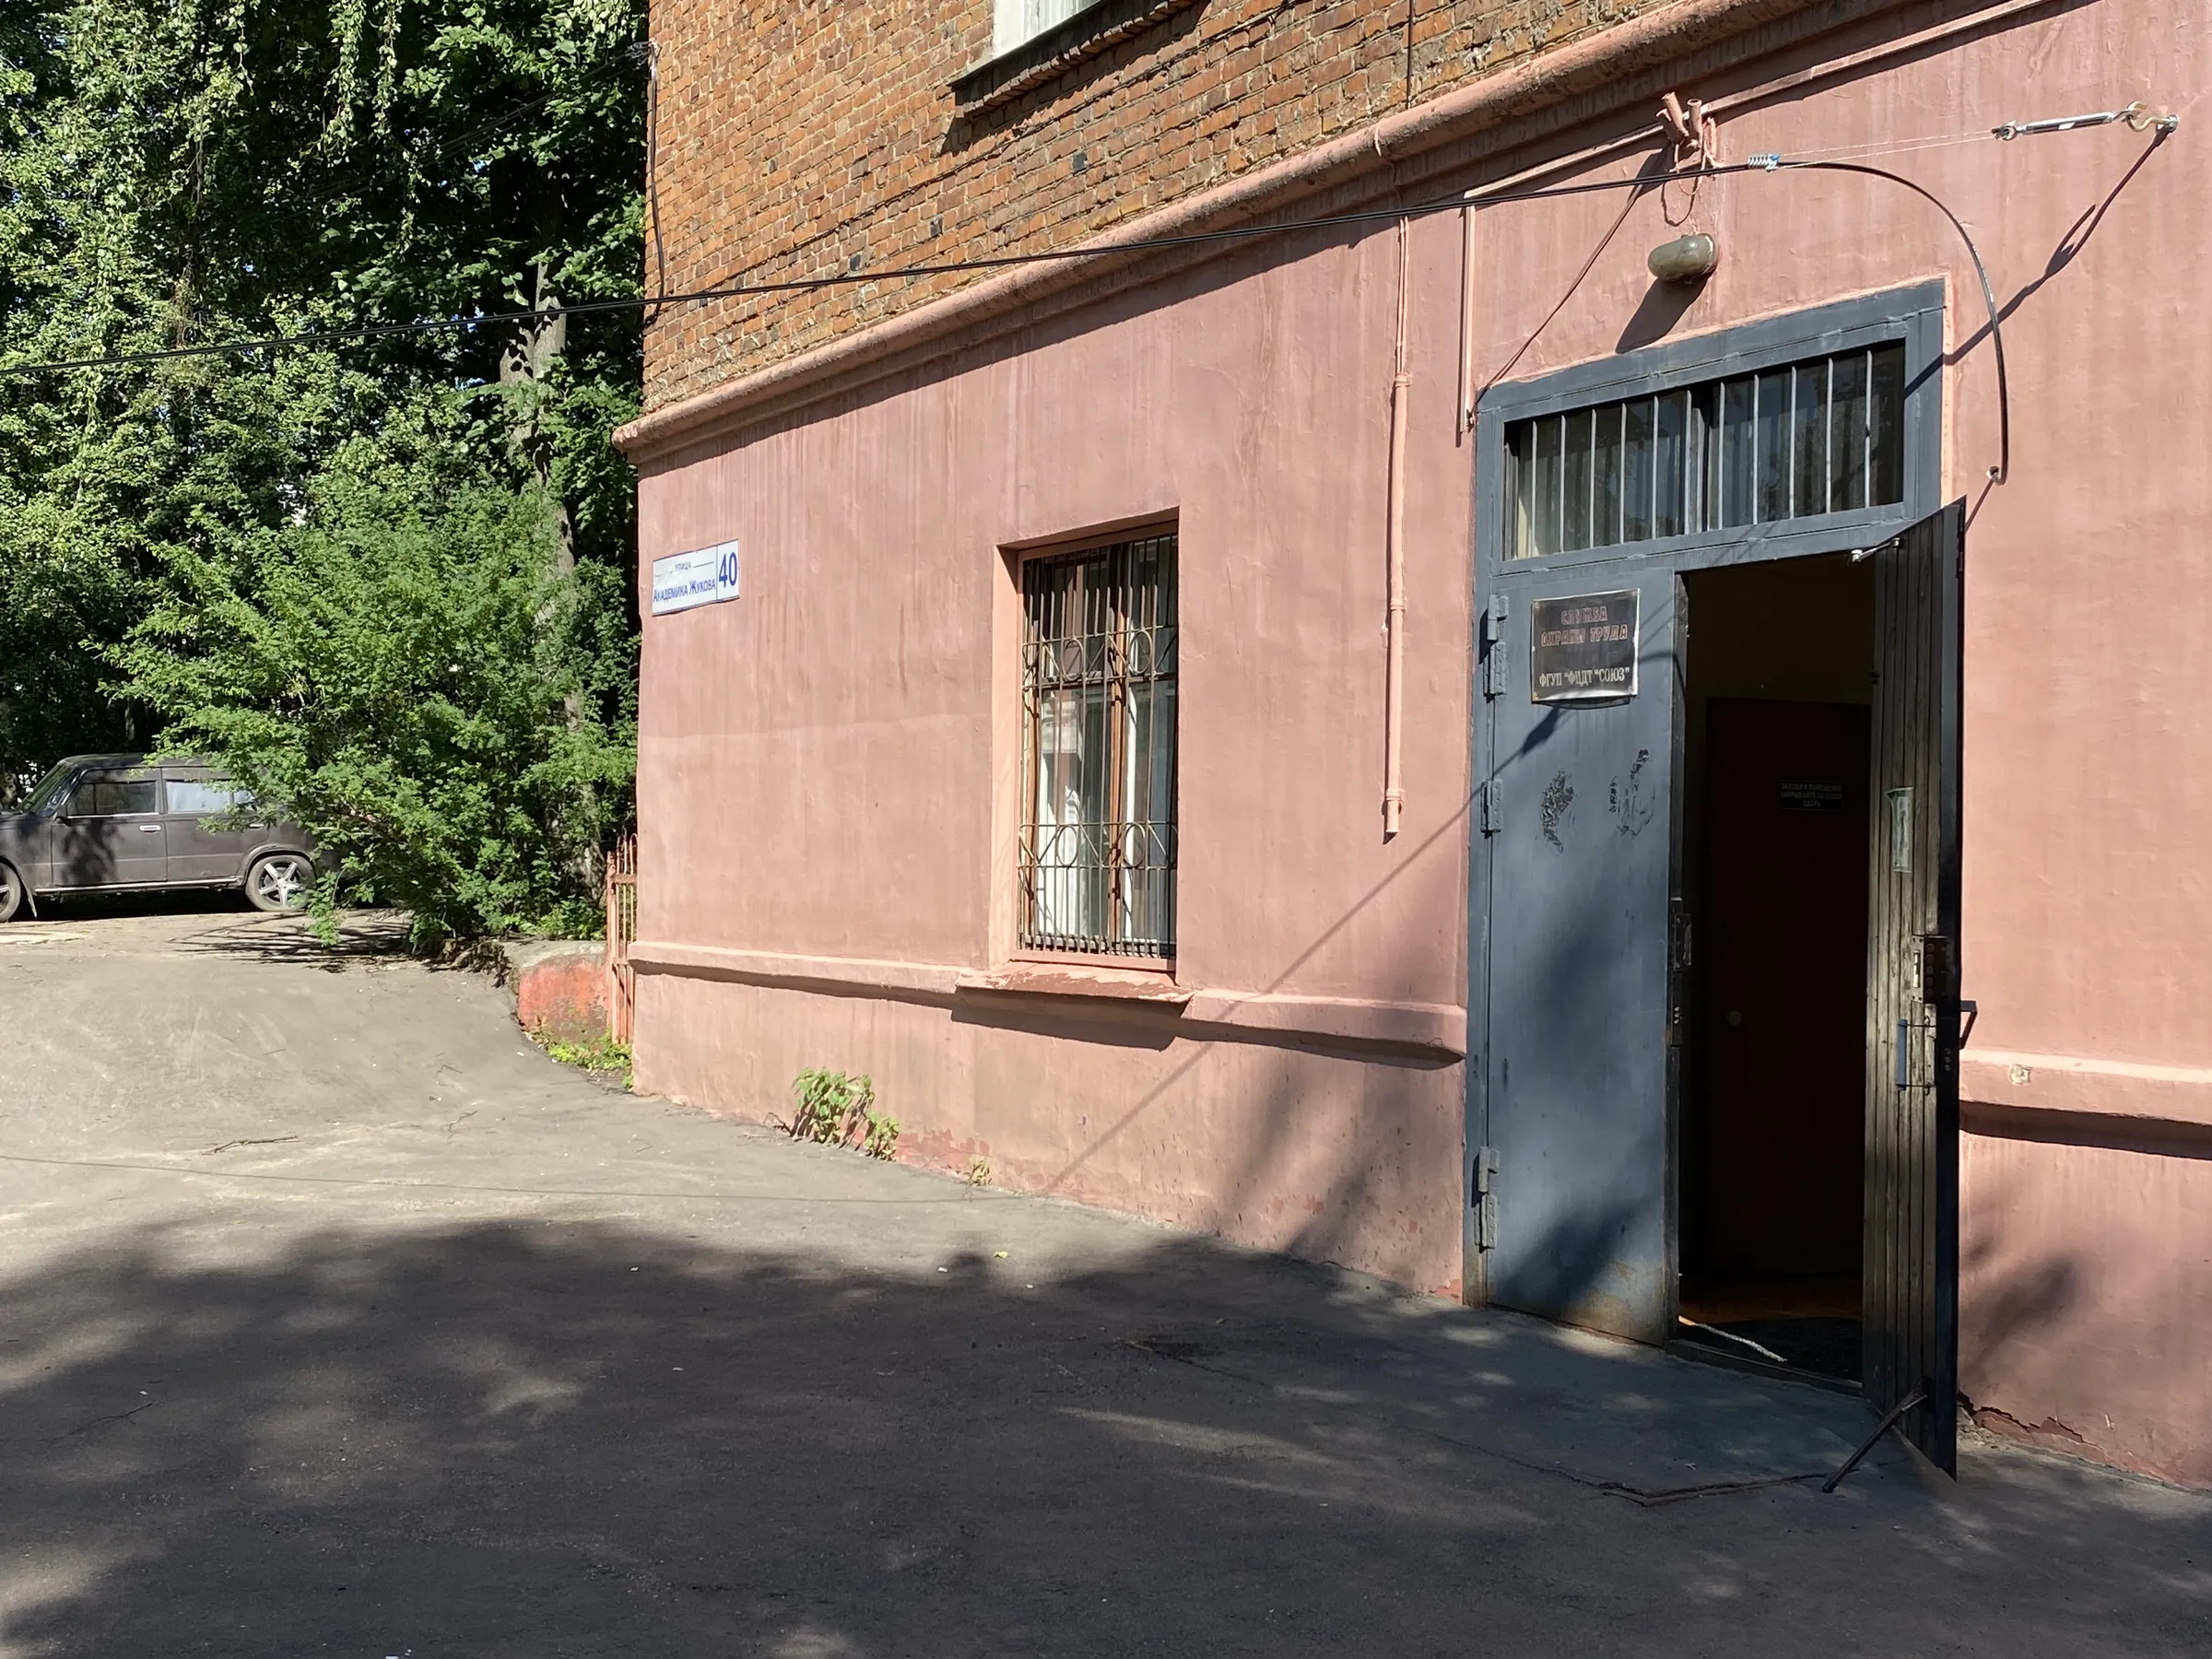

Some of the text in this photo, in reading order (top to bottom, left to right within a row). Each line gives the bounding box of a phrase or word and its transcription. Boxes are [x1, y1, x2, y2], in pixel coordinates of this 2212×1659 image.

[719, 552, 737, 588] 40
[1561, 606, 1608, 626] СЛУЖБА
[1541, 624, 1628, 647] ОХРАНЫ ТРУДА
[1539, 673, 1563, 688] ФГУП
